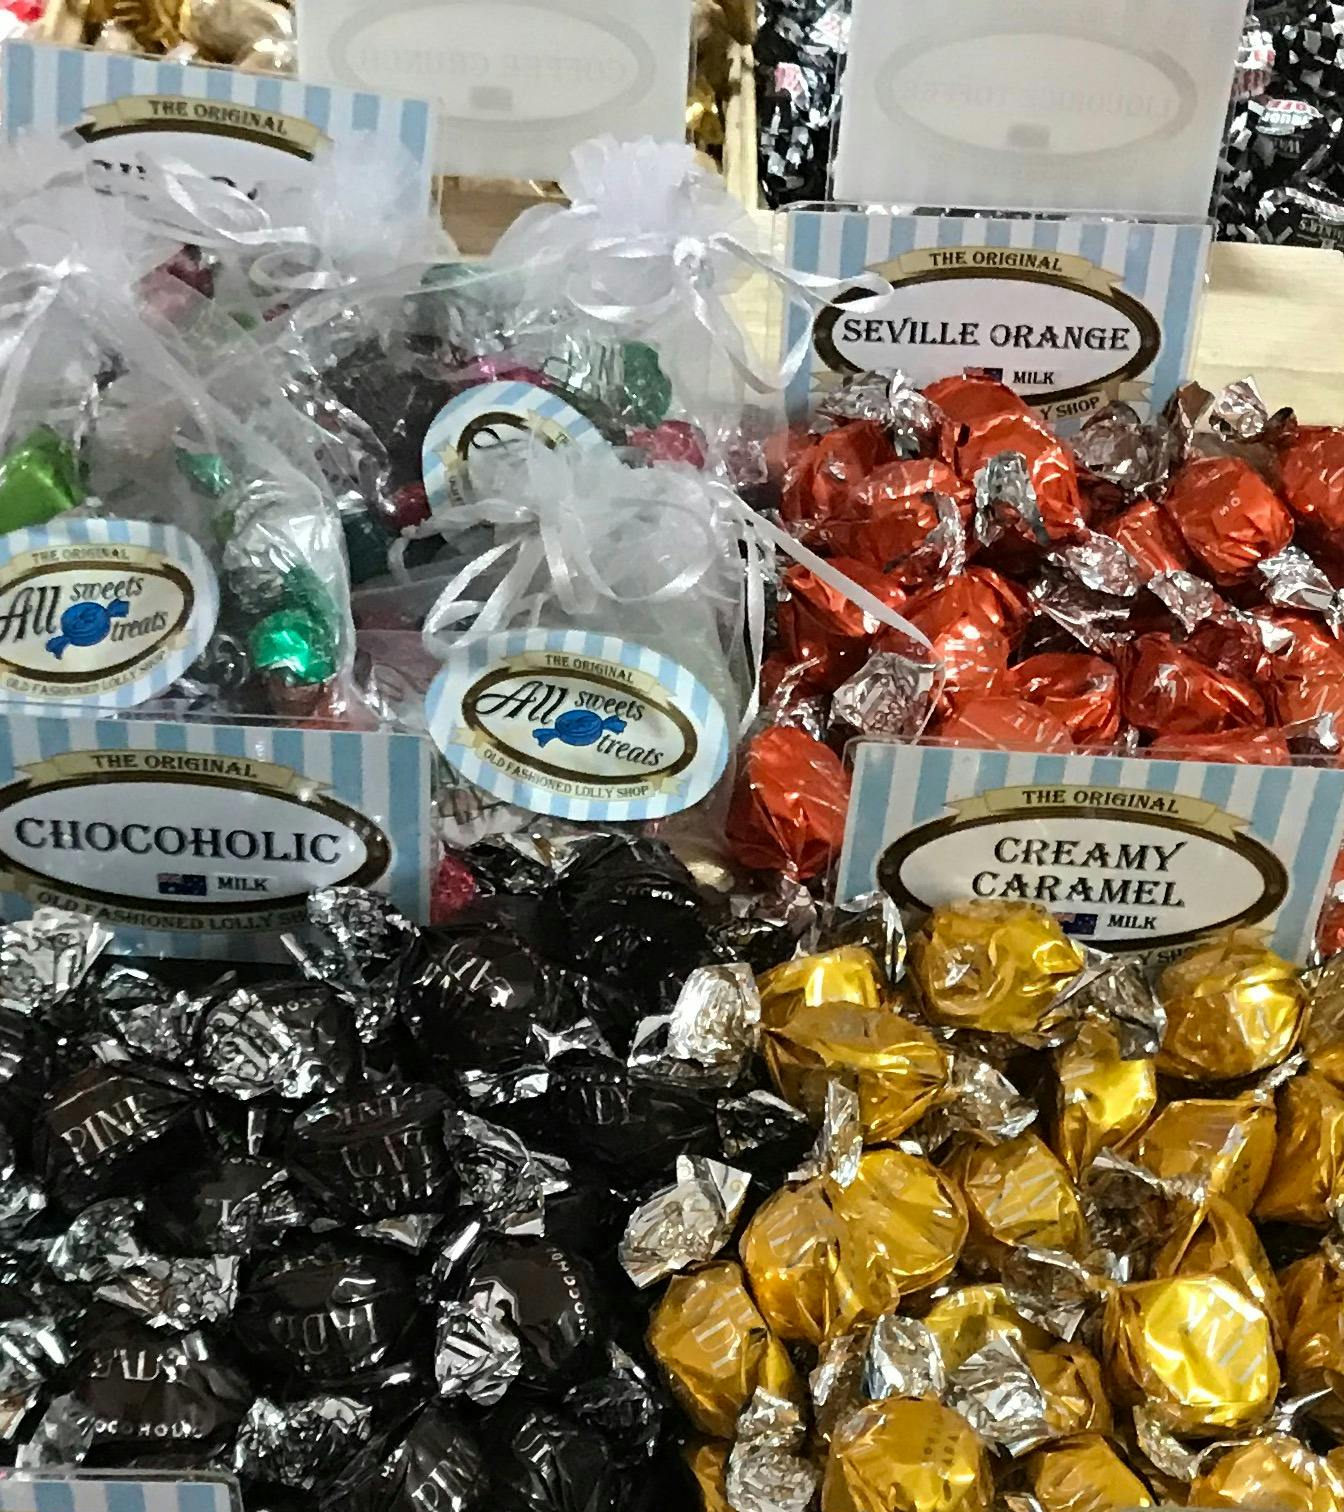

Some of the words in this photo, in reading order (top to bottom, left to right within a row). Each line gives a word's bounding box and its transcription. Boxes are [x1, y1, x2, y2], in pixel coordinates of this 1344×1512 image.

[148, 99, 188, 118] THE
[193, 102, 288, 136] ORIGINAL
[929, 252, 965, 266] THE
[973, 250, 1063, 273] ORIGINAL
[842, 317, 981, 346] SEVILLE
[989, 322, 1130, 351] ORANGE
[1013, 370, 1054, 385] MILK
[1056, 396, 1100, 419] SHOP
[70, 576, 144, 602] sweets
[111, 611, 168, 642] treats
[544, 655, 569, 667] THE
[573, 658, 634, 684] ORIGINAL
[474, 680, 569, 725] All
[574, 690, 645, 721] sweets
[91, 753, 139, 770] THE
[144, 754, 256, 777] ORIGINAL
[597, 734, 664, 767] treats
[484, 749, 505, 769] OLD
[506, 762, 572, 794] FASHIONED
[574, 786, 613, 799] LOLLY
[617, 785, 649, 798] SHOP
[1022, 789, 1066, 805] THE
[1074, 789, 1180, 813] ORIGINAL
[15, 817, 342, 865] CHOCOHOLIC
[994, 836, 1187, 872] CREAMY
[217, 876, 269, 892] MILK
[972, 870, 1185, 908] CARAMEL
[37, 890, 78, 912] OLD
[82, 906, 204, 930] FASHIONED
[209, 914, 272, 929] LOLLY
[275, 911, 307, 928] SH
[1107, 914, 1157, 930] MILK
